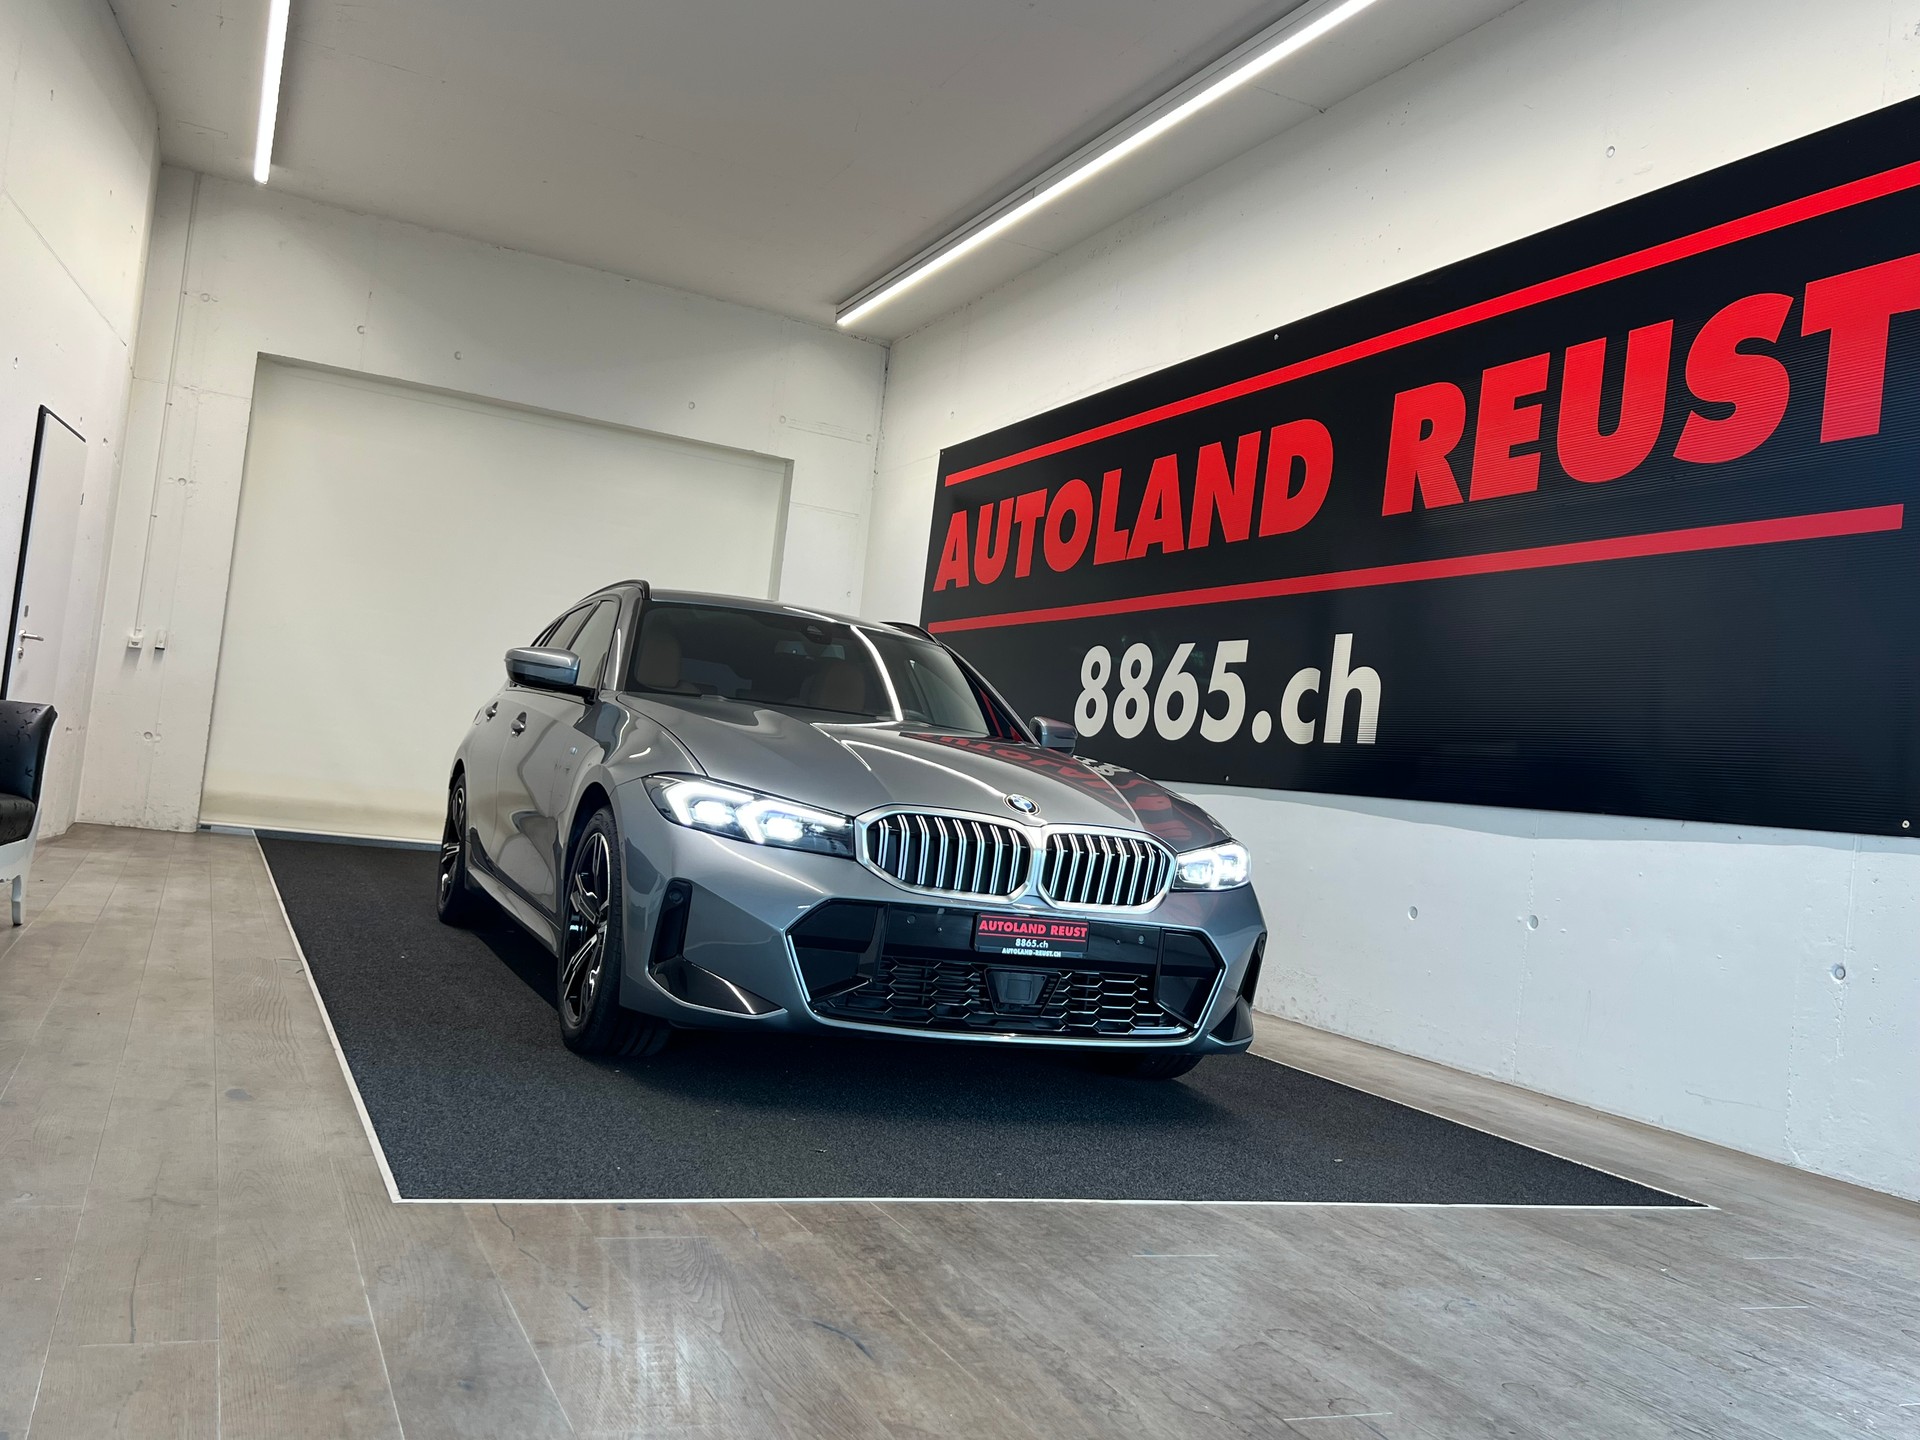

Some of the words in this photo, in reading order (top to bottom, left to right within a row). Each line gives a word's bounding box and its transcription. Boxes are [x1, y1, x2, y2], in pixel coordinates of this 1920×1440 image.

[933, 418, 1334, 592] AUTOLAND
[1381, 253, 1920, 517] REUST
[1074, 633, 1382, 745] 8865.ch
[979, 920, 1047, 935] AUTOLAND
[1050, 925, 1088, 938] REUST
[1015, 938, 1049, 949] 8865.ch
